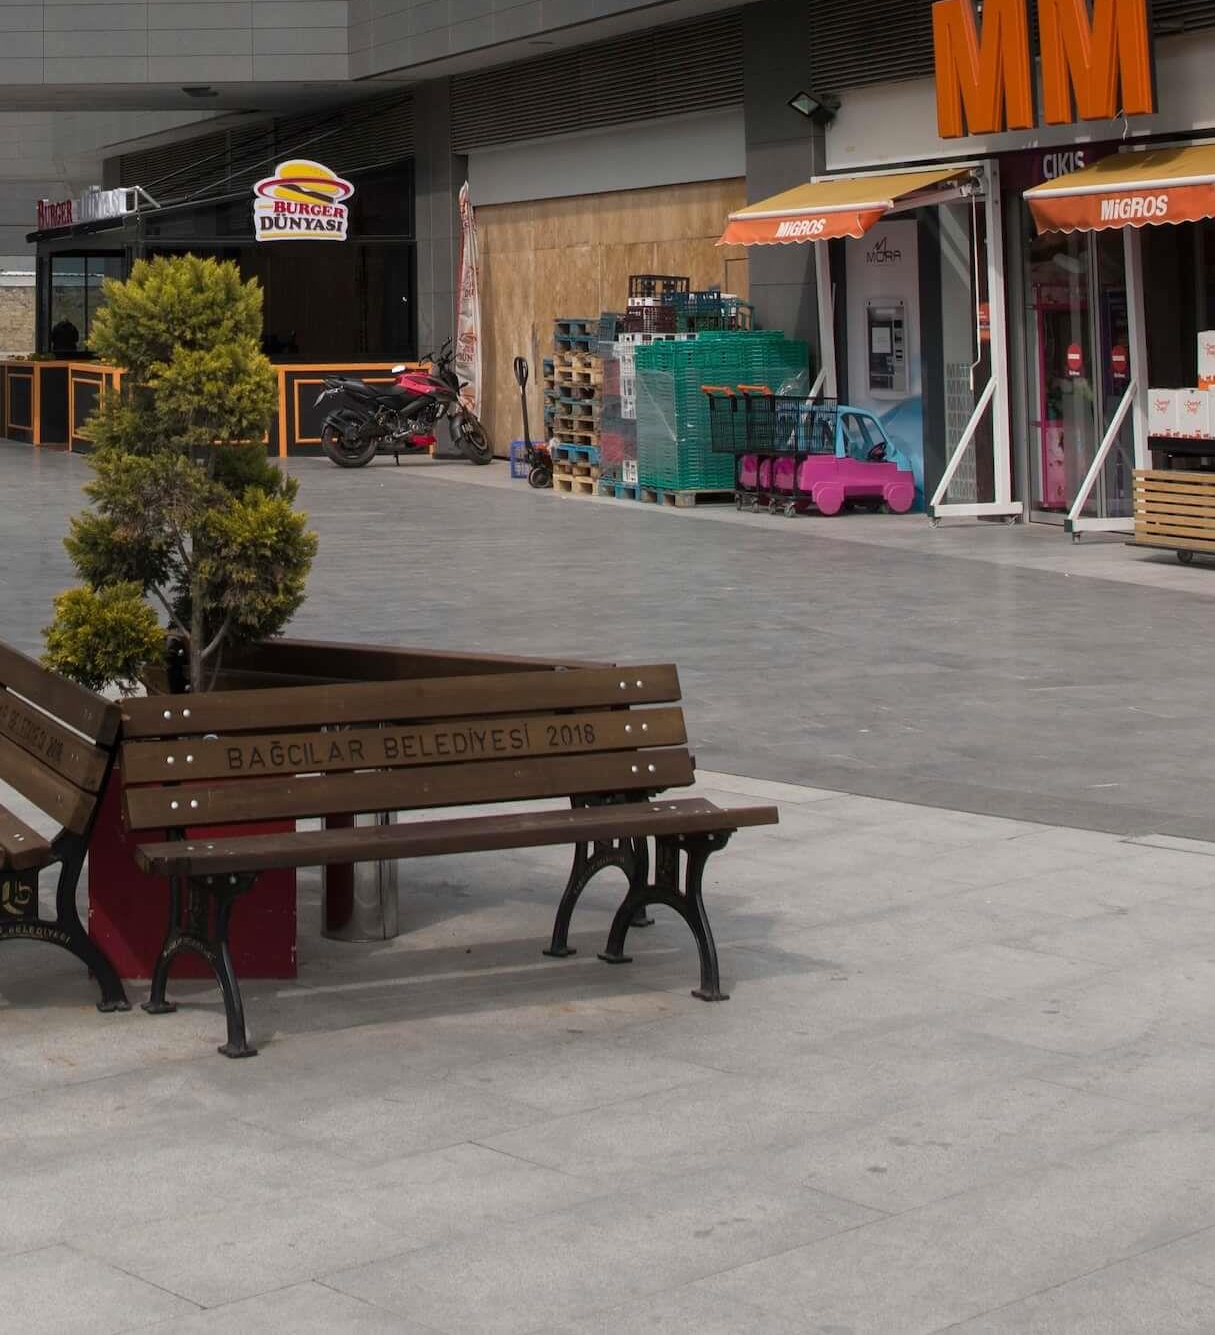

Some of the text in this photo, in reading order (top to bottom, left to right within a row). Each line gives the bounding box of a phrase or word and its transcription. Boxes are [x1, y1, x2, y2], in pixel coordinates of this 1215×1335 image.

[272, 200, 344, 219] BURGER
[260, 213, 344, 232] DÜNYASI
[226, 723, 596, 770] BAĞCILAR BELEDİYESİ 2018
